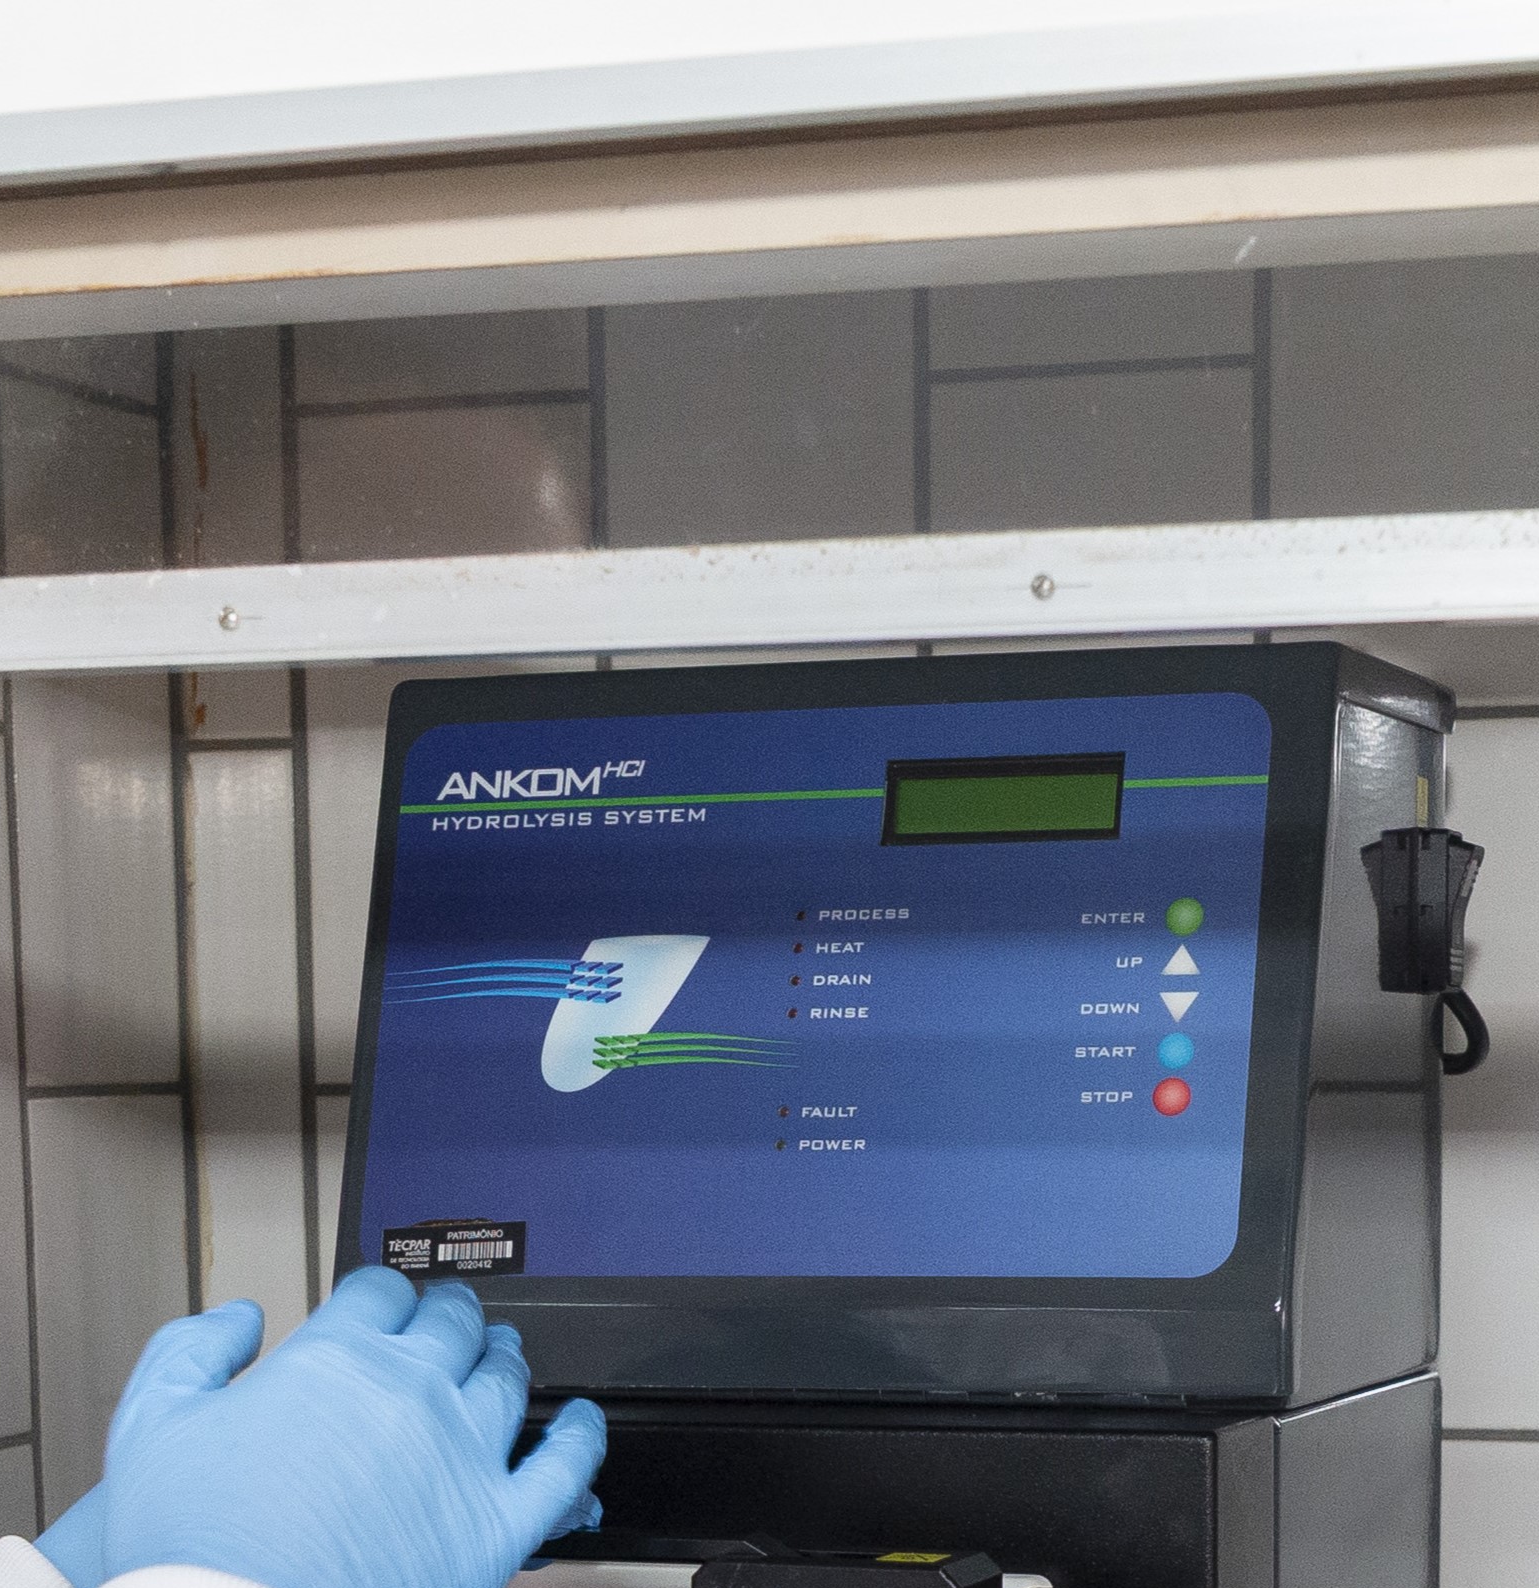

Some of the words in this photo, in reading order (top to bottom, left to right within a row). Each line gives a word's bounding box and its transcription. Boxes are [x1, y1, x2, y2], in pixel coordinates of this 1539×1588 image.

[437, 767, 601, 801] ANKOM
[432, 812, 593, 831] HYDROLYSIS
[604, 808, 707, 825] SYSTEM
[818, 908, 910, 921] PROCESS
[1081, 912, 1146, 924] ENTER
[815, 942, 865, 954] HEAT
[1116, 956, 1143, 968] UP
[812, 974, 872, 986] DRAIN
[810, 1007, 869, 1019] RINSE
[1080, 1003, 1140, 1015] DOWN
[1074, 1046, 1136, 1058] START
[1080, 1091, 1133, 1103] STOP
[801, 1106, 858, 1118] FAULT
[799, 1139, 866, 1151] POWER
[446, 1229, 504, 1241] PATRIMÔNIO
[457, 1259, 493, 1270] 0020412
